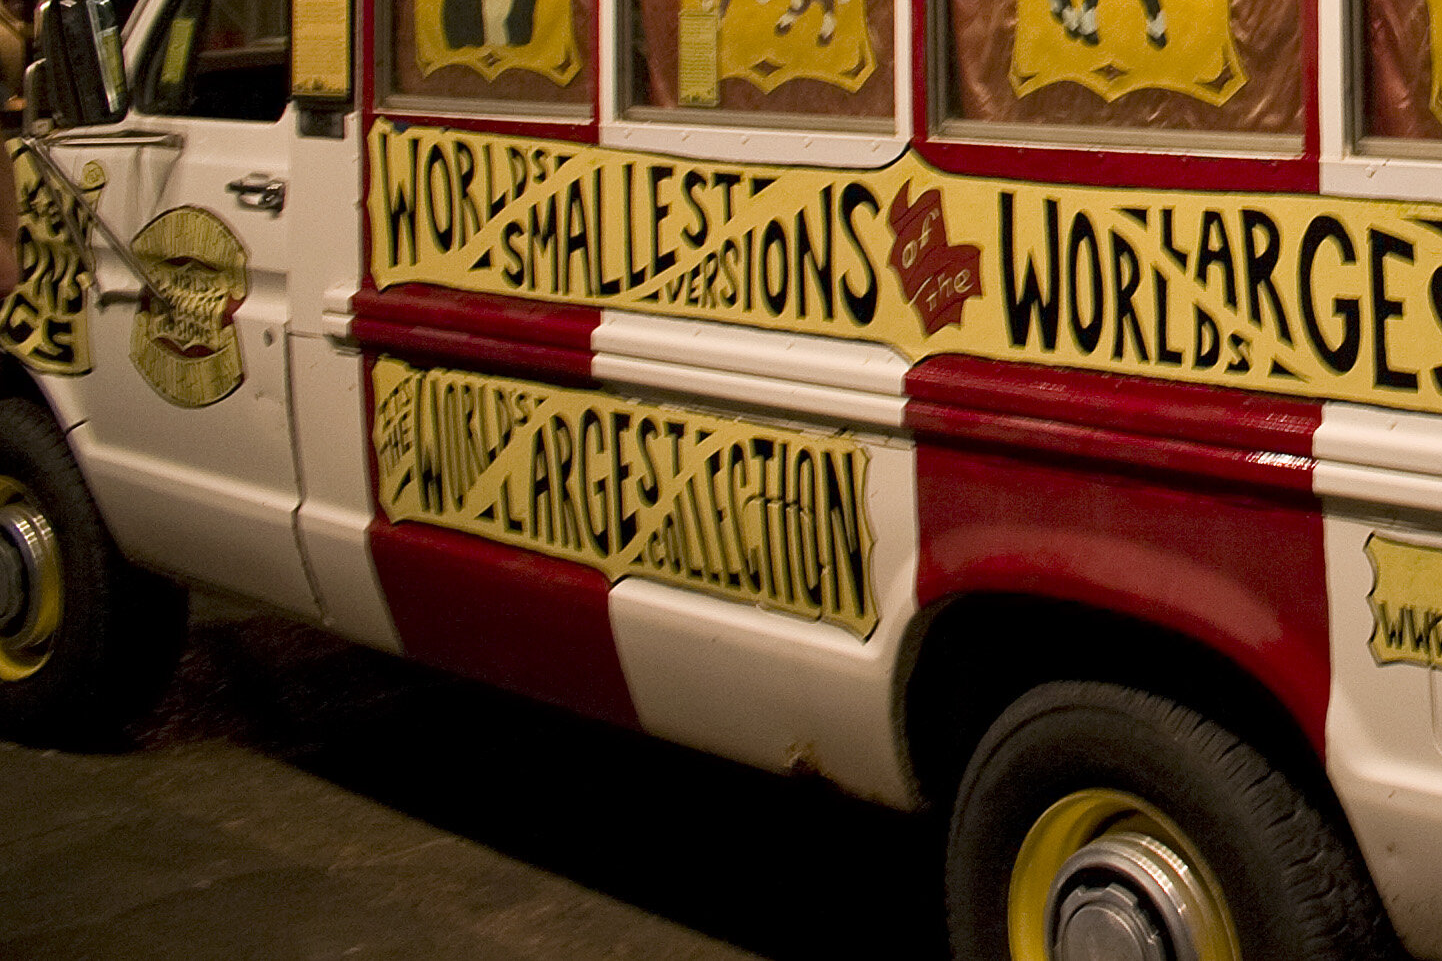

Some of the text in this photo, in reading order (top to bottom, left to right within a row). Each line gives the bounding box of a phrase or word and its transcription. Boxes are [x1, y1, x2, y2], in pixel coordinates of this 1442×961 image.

[500, 156, 748, 299] SMALLEST
[662, 181, 882, 329] VERSIONS
[901, 206, 941, 271] of
[500, 407, 688, 558] LARGEST
[644, 436, 868, 620] COLLECTION
